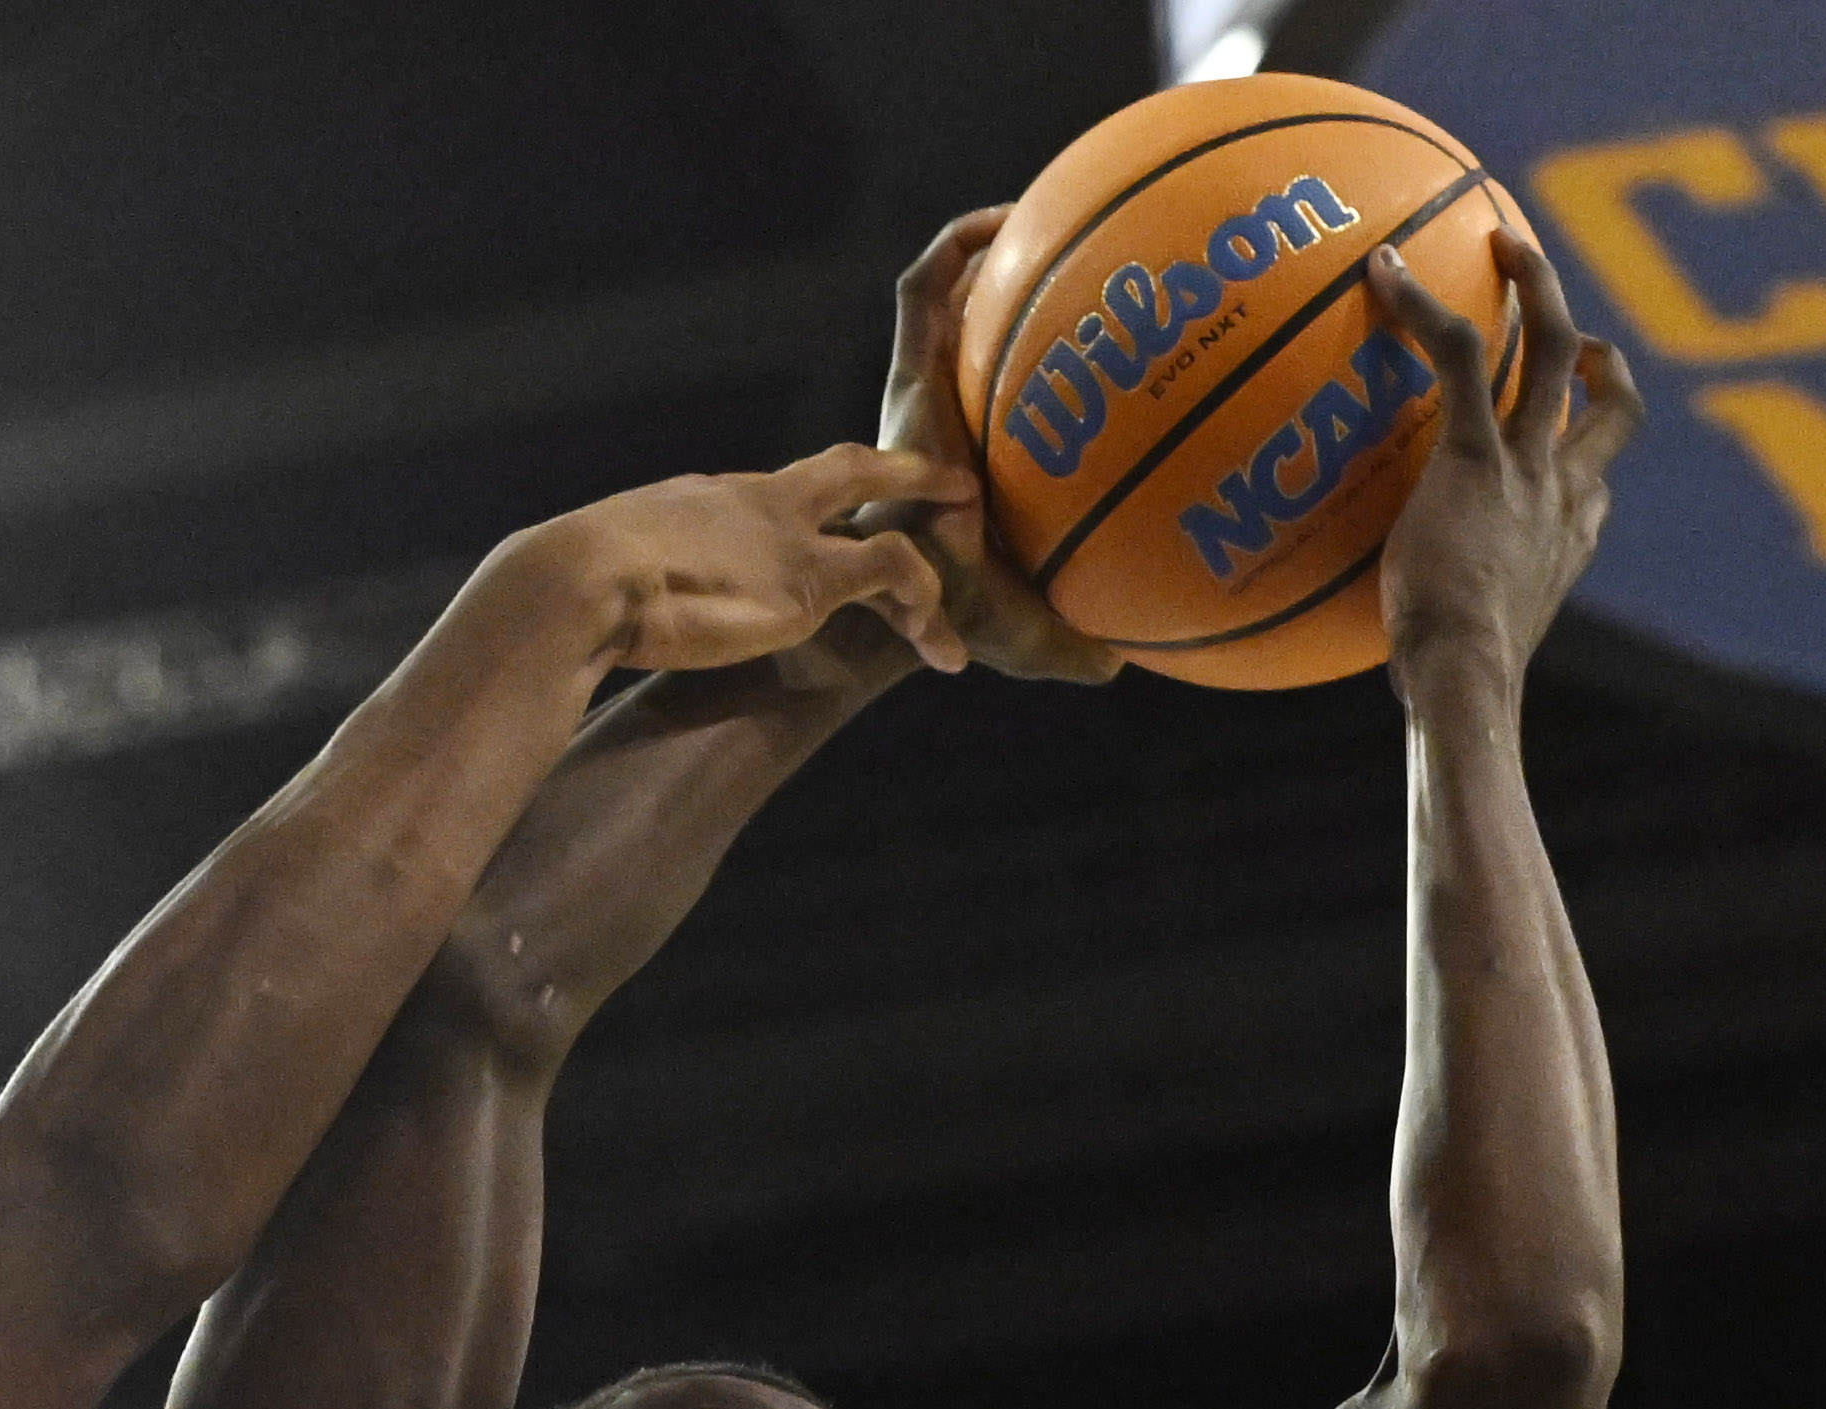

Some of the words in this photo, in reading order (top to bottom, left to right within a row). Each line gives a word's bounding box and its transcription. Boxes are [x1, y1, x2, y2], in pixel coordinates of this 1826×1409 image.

[1003, 173, 1361, 479] Wilson
[1148, 350, 1195, 400] EVO
[1198, 302, 1248, 350] NXT
[1178, 327, 1438, 581] NCAA
